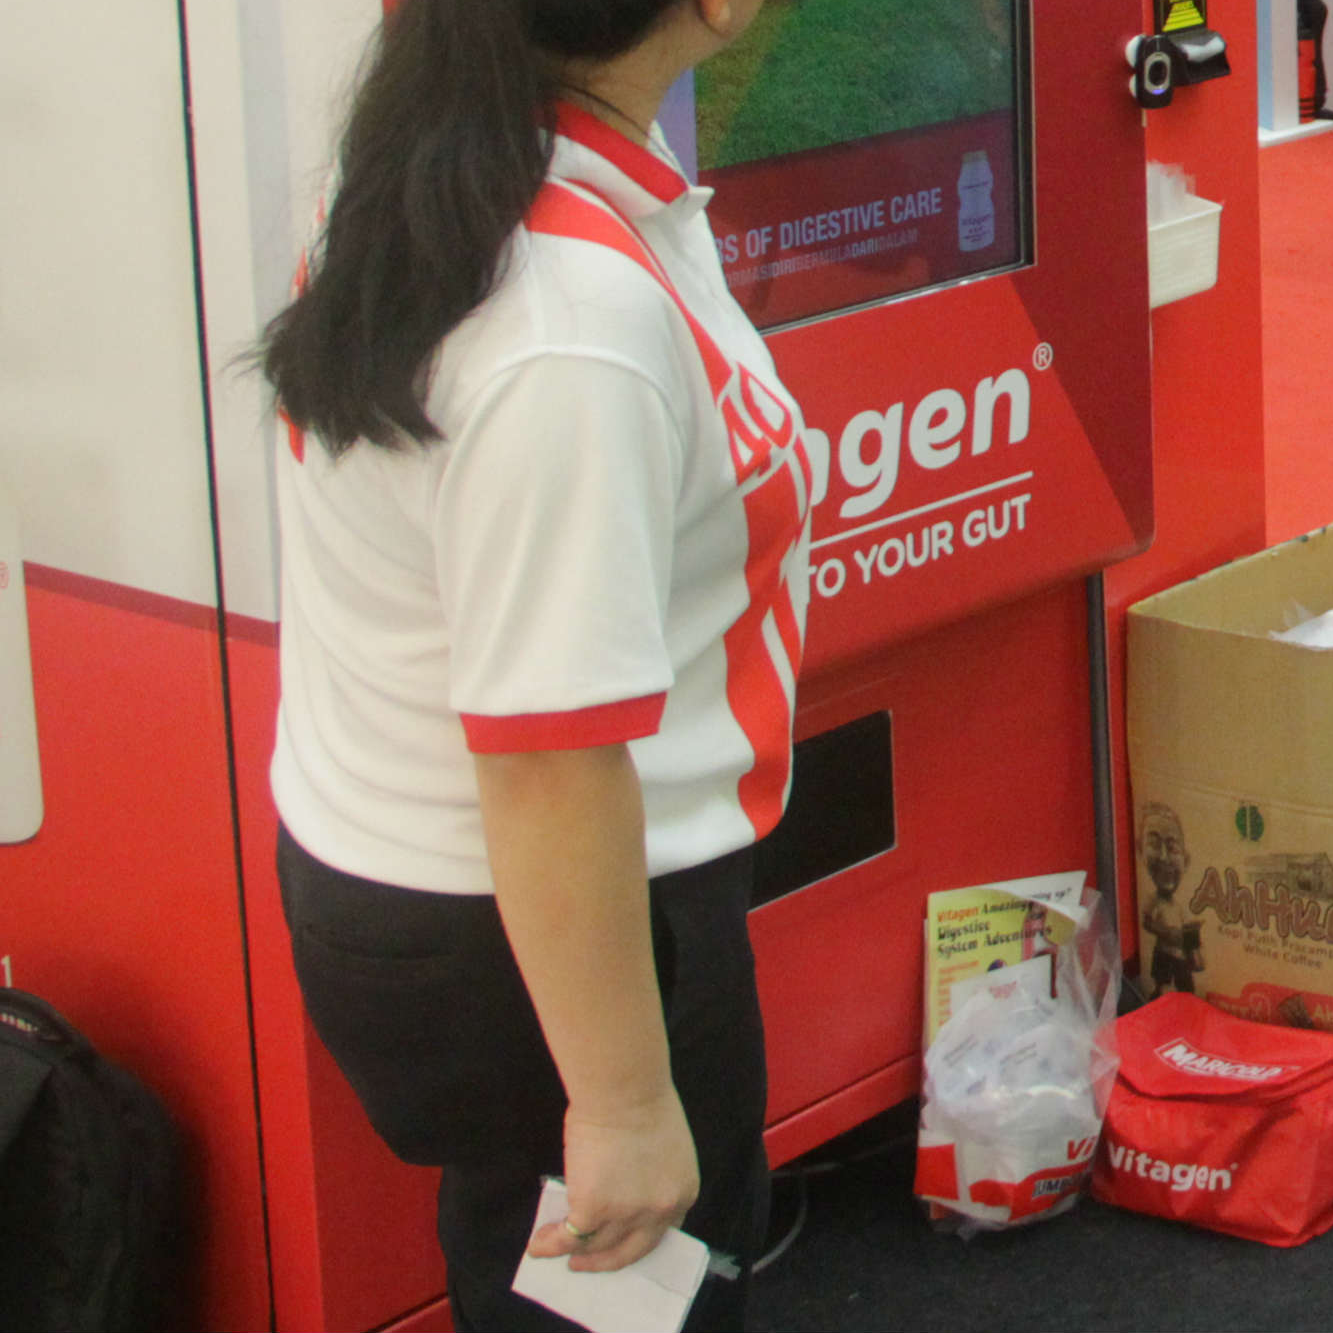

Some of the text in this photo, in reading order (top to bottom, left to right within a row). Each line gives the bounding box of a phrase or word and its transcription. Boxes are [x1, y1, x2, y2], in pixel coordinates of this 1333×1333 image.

[746, 226, 772, 258] OF
[780, 200, 884, 250] DIGESTIVE
[890, 187, 942, 224] CARE
[853, 524, 954, 583] YOUR
[962, 493, 1032, 547] GUT
[1108, 1141, 1232, 1192] Vitagen
